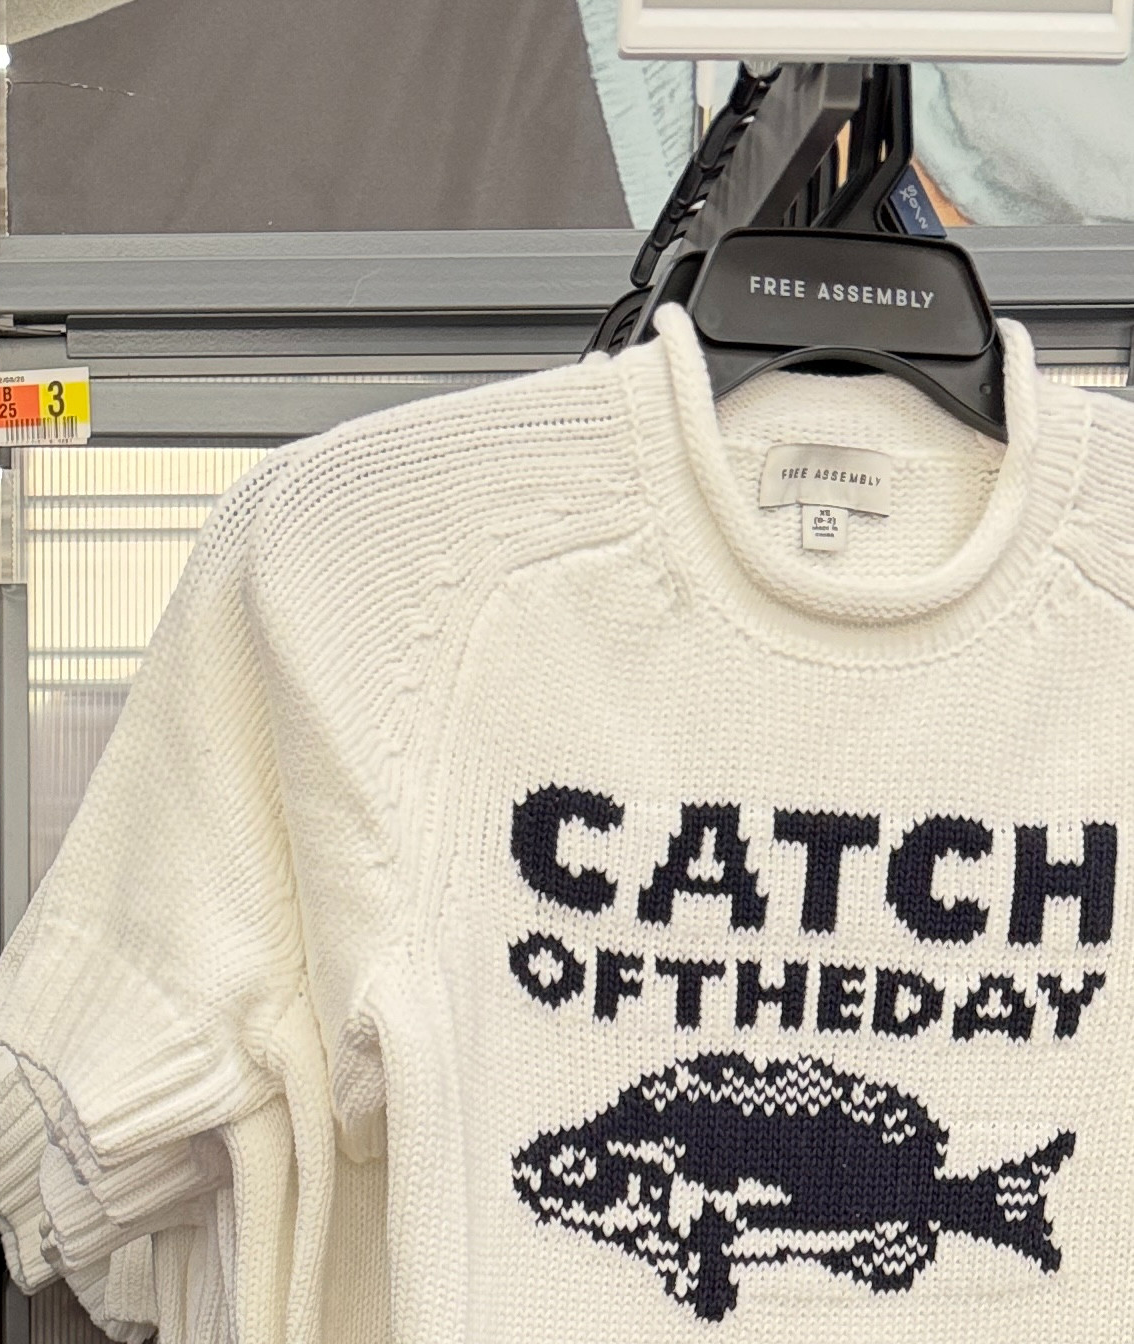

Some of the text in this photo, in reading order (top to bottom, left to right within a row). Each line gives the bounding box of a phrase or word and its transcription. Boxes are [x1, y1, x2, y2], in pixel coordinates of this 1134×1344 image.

[750, 275, 935, 309] FREE ASSEMBLY
[2, 386, 12, 402] B
[47, 380, 65, 417] 3
[781, 467, 881, 487] FREE ASSEMBLY
[511, 782, 1118, 948] CATCH
